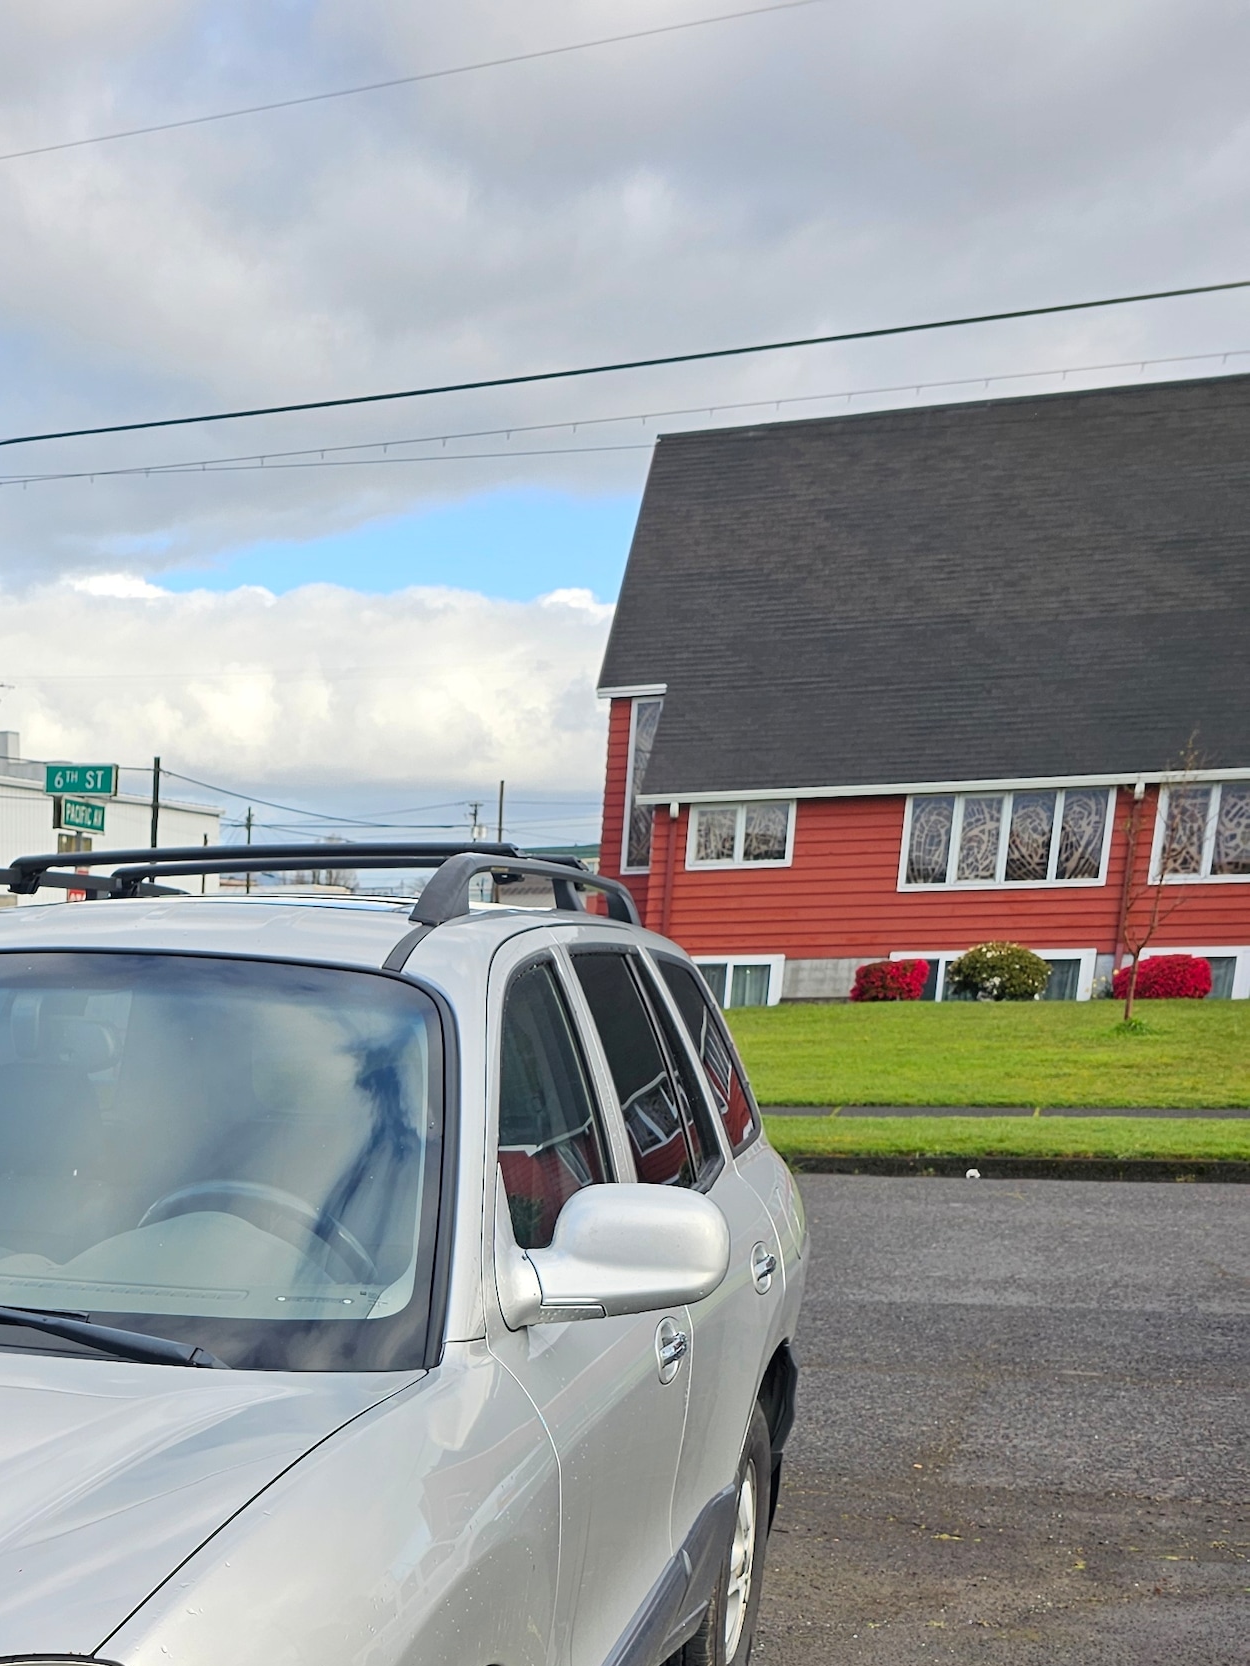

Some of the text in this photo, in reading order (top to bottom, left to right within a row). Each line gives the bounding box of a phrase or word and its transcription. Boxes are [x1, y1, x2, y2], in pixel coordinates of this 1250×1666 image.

[54, 770, 104, 789] 6TH ST
[66, 803, 92, 826] PACIFIC
